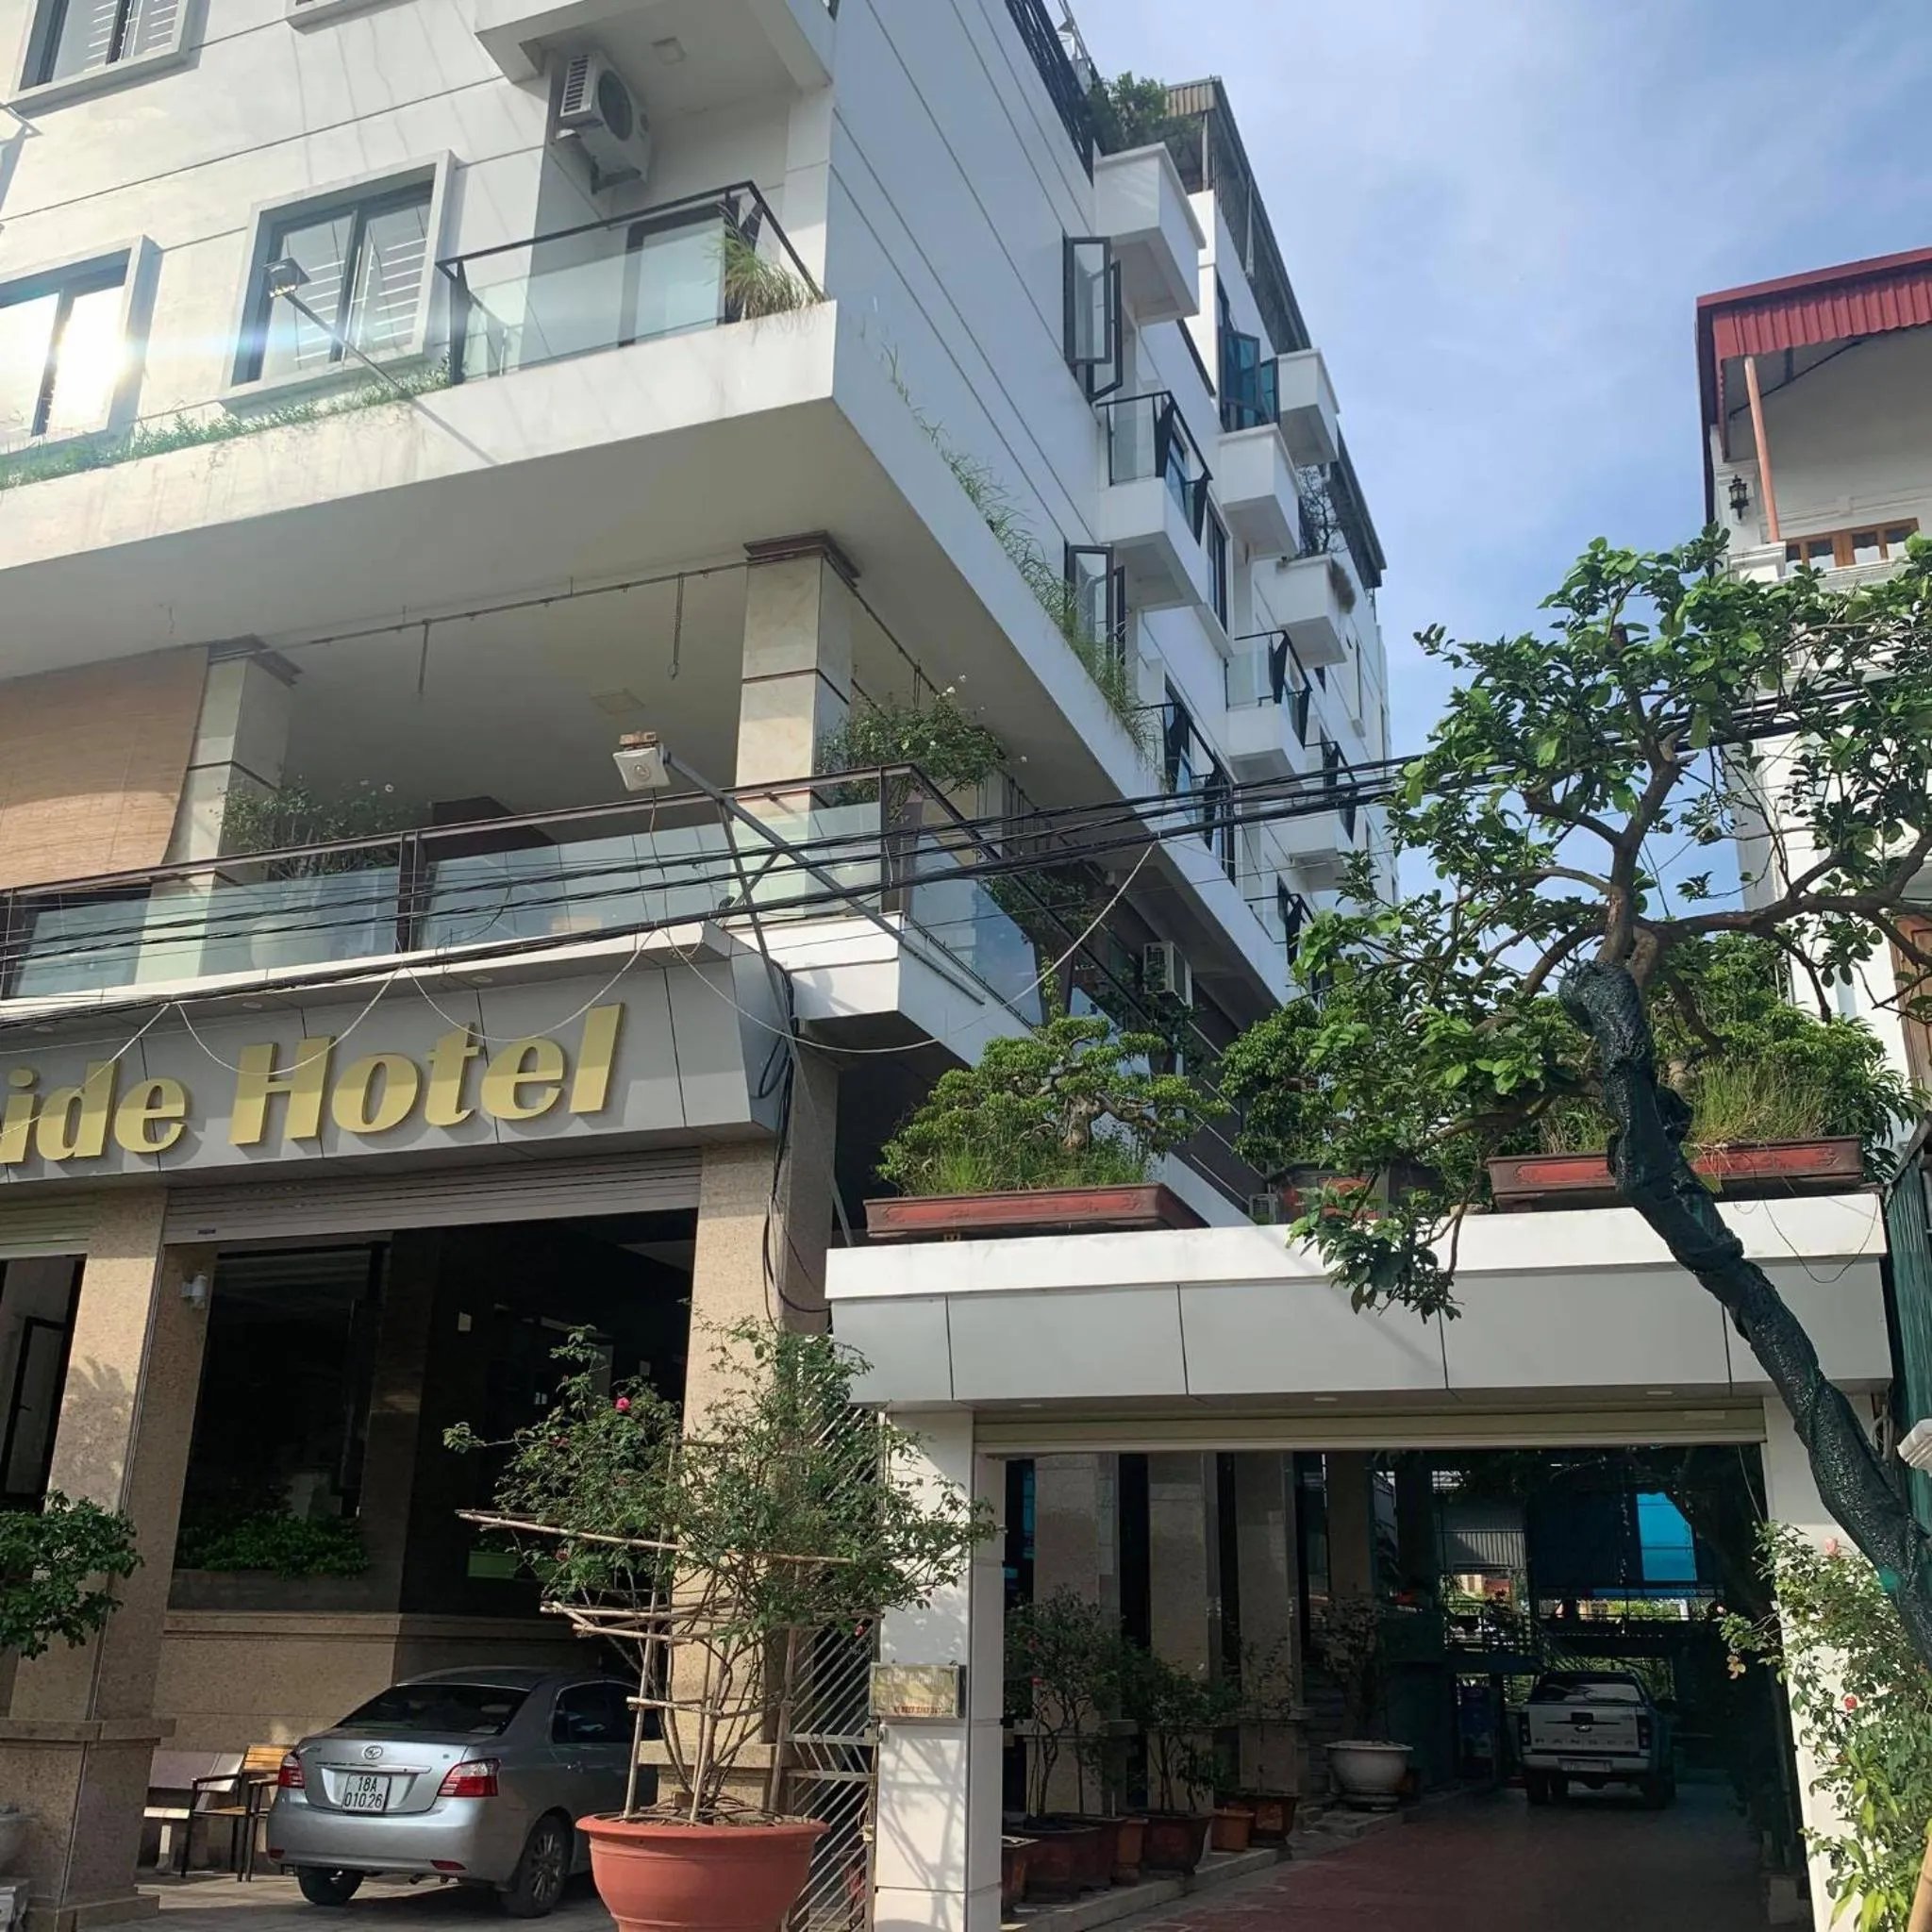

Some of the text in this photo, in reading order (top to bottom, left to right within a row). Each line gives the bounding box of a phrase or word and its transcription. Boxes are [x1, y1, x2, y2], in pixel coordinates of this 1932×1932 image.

[229, 1003, 624, 1145] Hotel
[358, 1776, 378, 1792] 18A
[344, 1792, 383, 1808] 01026
